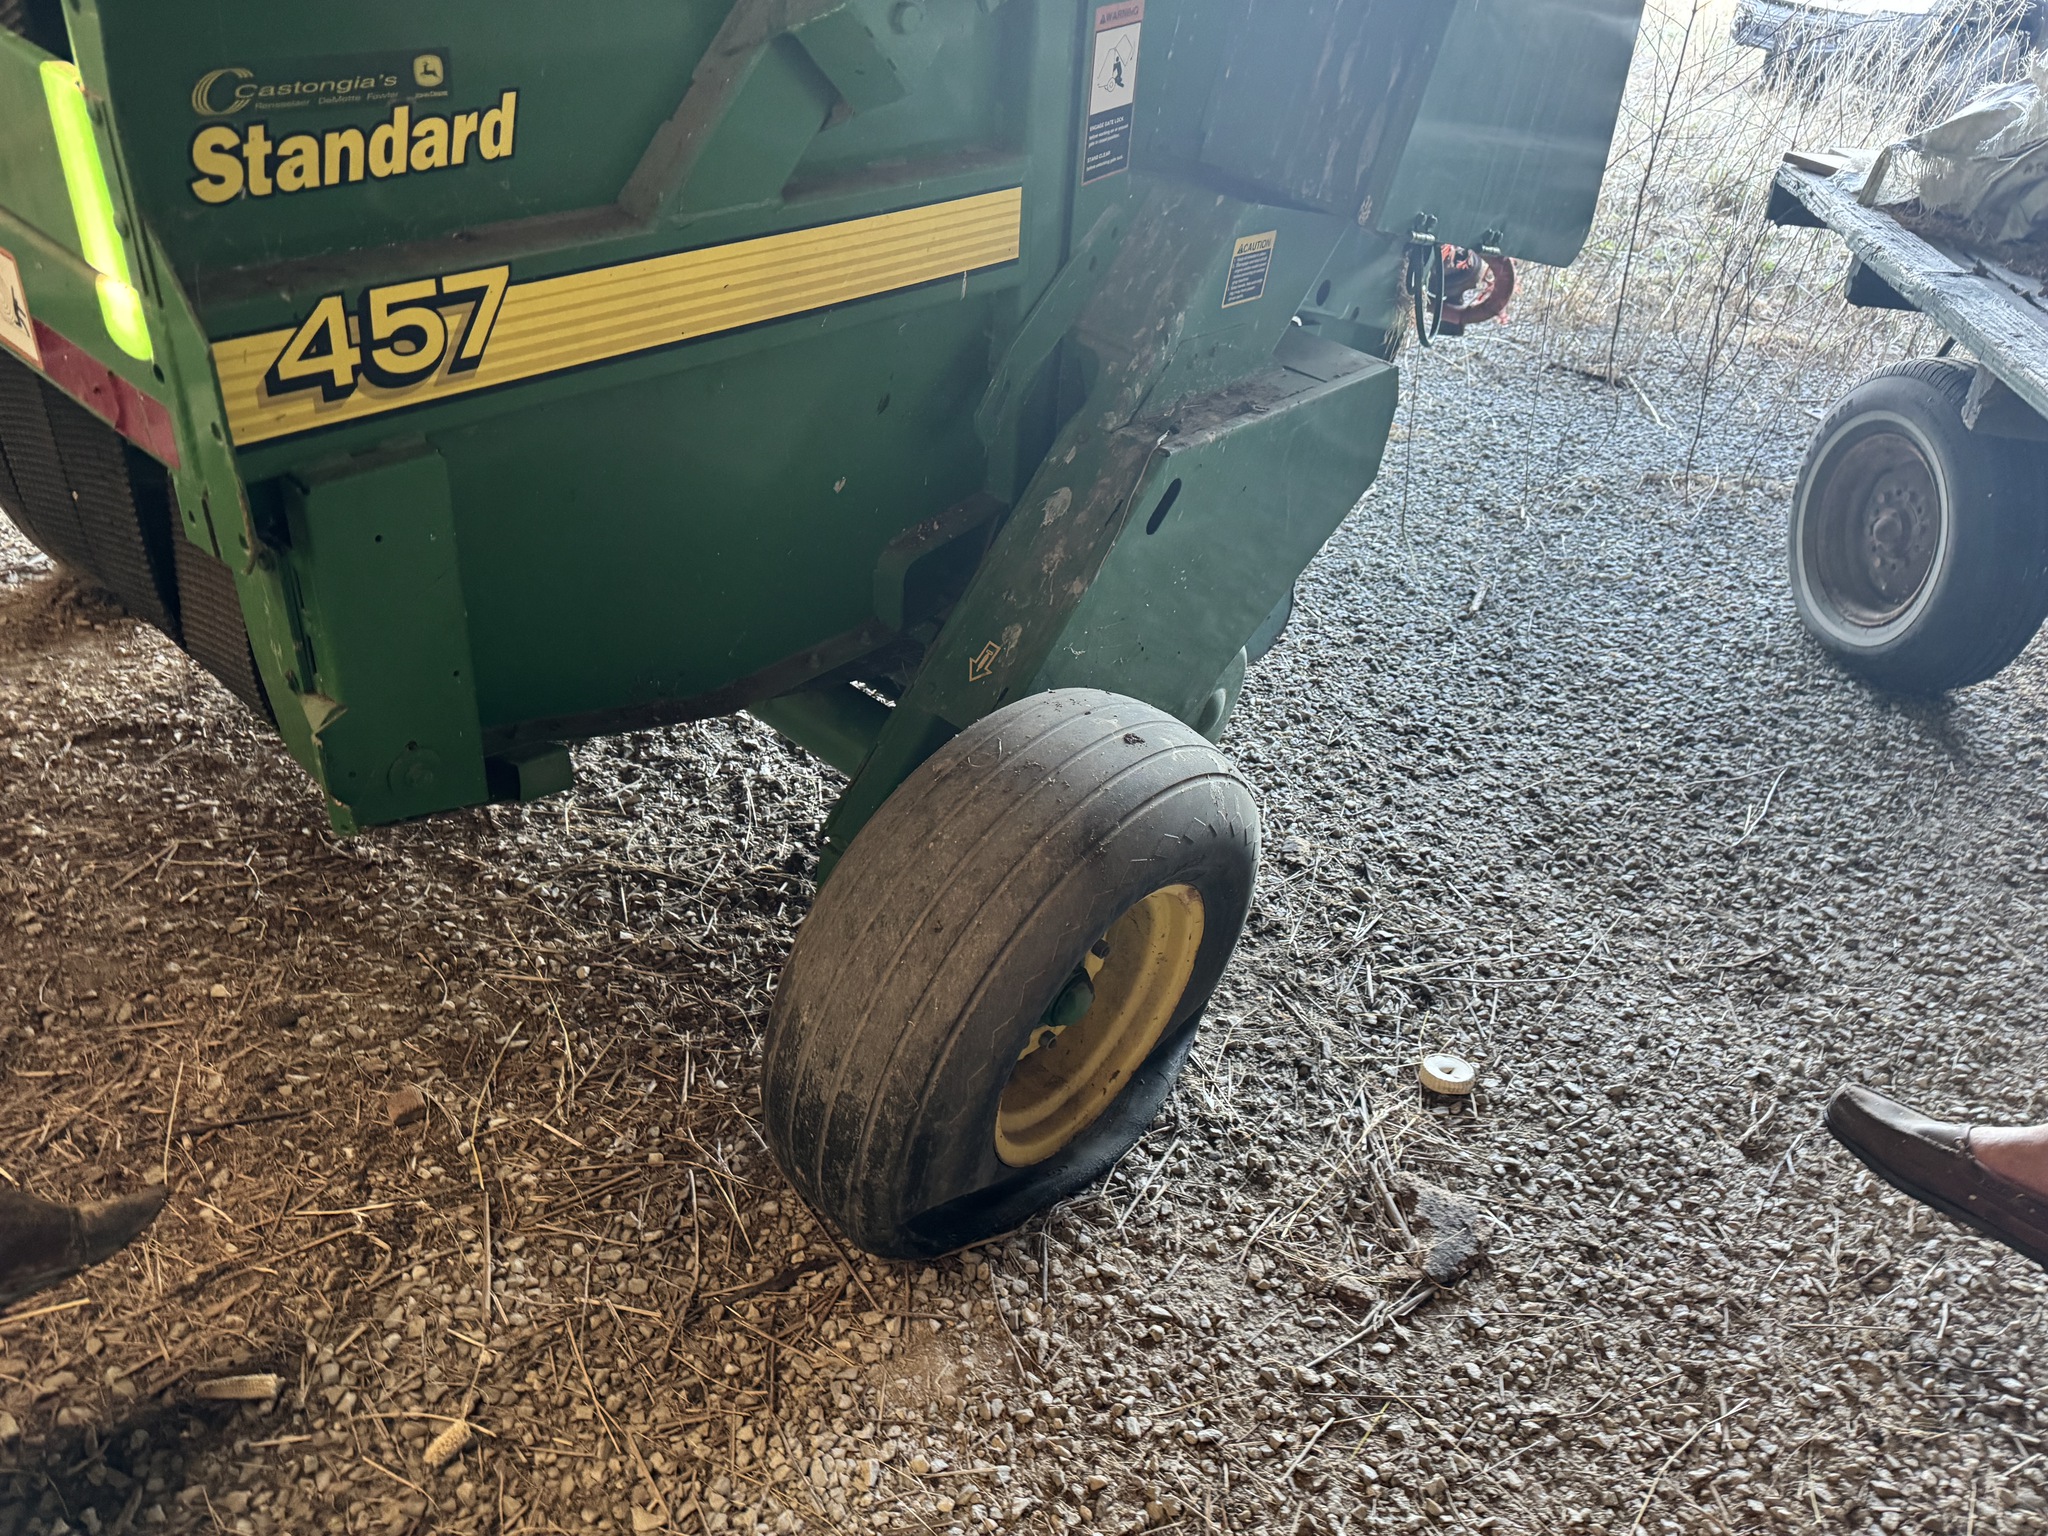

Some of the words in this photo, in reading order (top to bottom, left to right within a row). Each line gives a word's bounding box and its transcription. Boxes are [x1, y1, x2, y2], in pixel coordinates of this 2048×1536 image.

[1105, 5, 1139, 21] WARNING
[234, 73, 398, 98] Castongia's
[191, 90, 517, 204] Standard
[1243, 239, 1272, 252] CAUTION
[268, 264, 511, 398] 457
